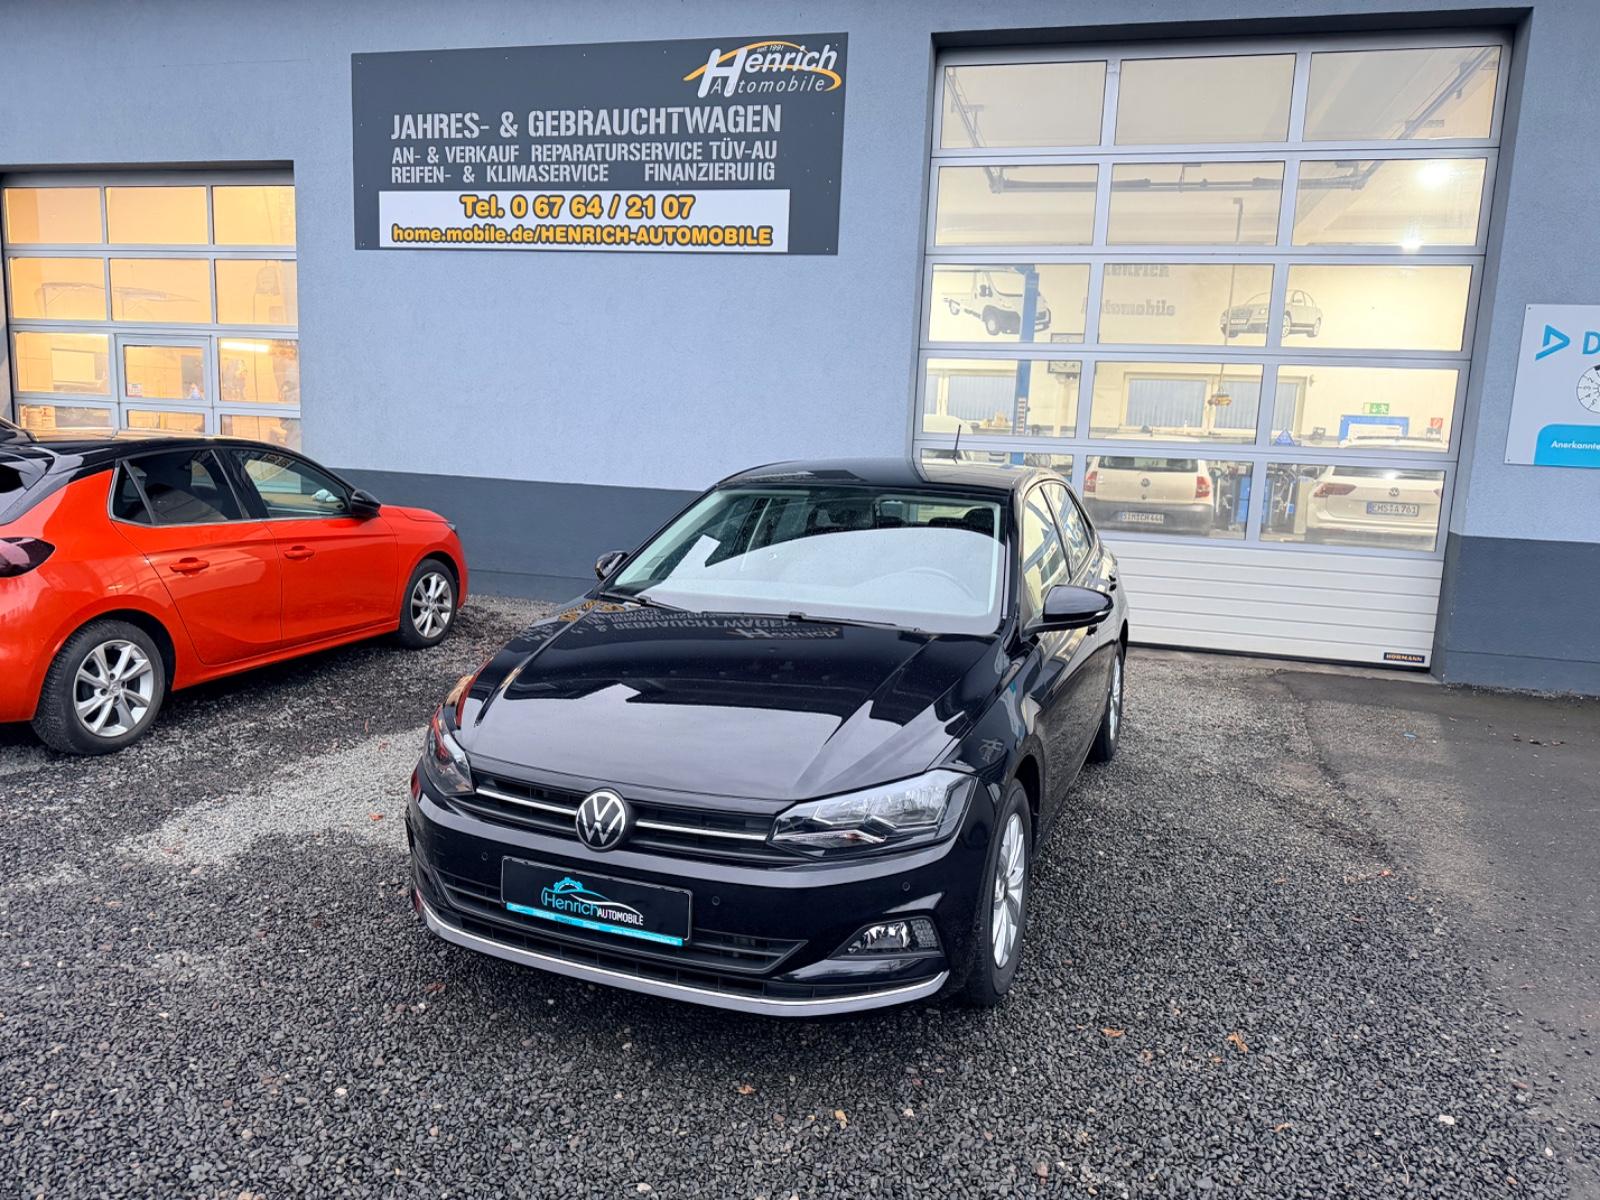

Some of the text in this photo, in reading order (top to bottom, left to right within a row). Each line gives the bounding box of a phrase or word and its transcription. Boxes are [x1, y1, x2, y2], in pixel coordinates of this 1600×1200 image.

[697, 44, 838, 98] Henrich
[391, 104, 782, 140] JAHRES- & GEBRAUCHTWAGEN
[392, 137, 778, 164] AN- & VERKAUF REPARATURSERVICE TÜV-AU
[391, 166, 452, 184] REIFEN-
[463, 165, 475, 183] &
[486, 164, 609, 183] KLIMASERVICE
[459, 193, 696, 219] Tel. 0 67 64 / 21 07
[391, 223, 774, 247] home.mobile.de/HENRICH-AUTOMOBILE
[544, 892, 599, 916] Henrich
[596, 907, 644, 926] AUTOMOBILE
